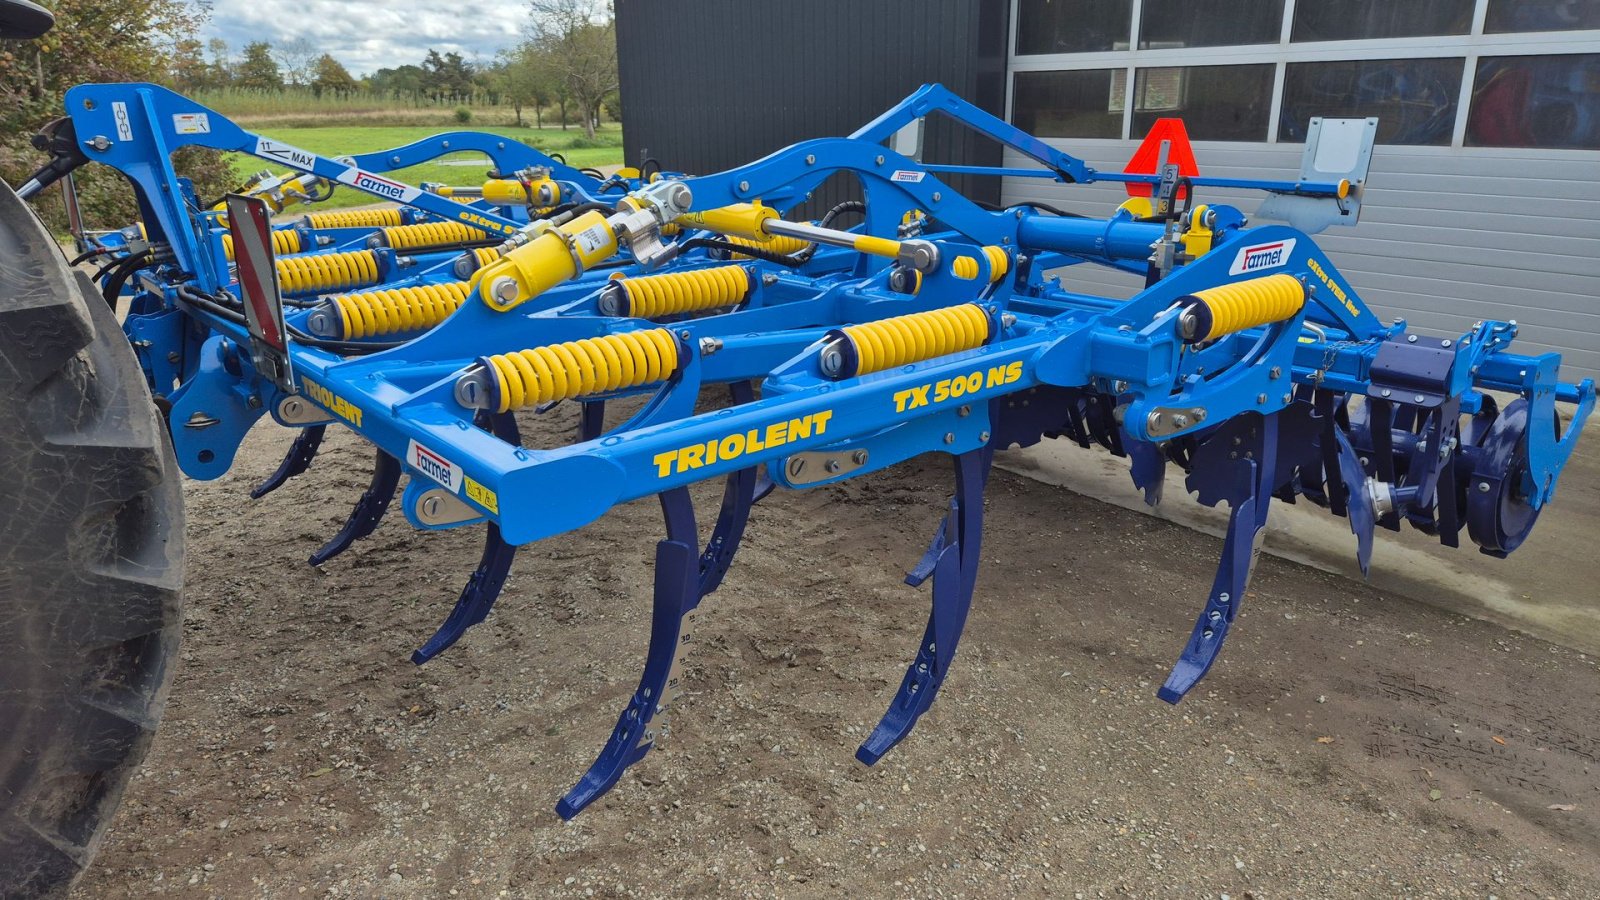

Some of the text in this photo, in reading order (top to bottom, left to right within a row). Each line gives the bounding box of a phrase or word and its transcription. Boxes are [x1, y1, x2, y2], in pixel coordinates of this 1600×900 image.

[291, 152, 313, 168] MAX
[353, 171, 406, 199] Farmet
[1161, 200, 1168, 212] 3
[1242, 242, 1284, 271] Farmet
[300, 374, 363, 428] TRIOLENT
[893, 360, 1023, 413] TX 500 NS
[653, 409, 833, 478] TRIOLENT
[415, 444, 452, 487] Farmet
